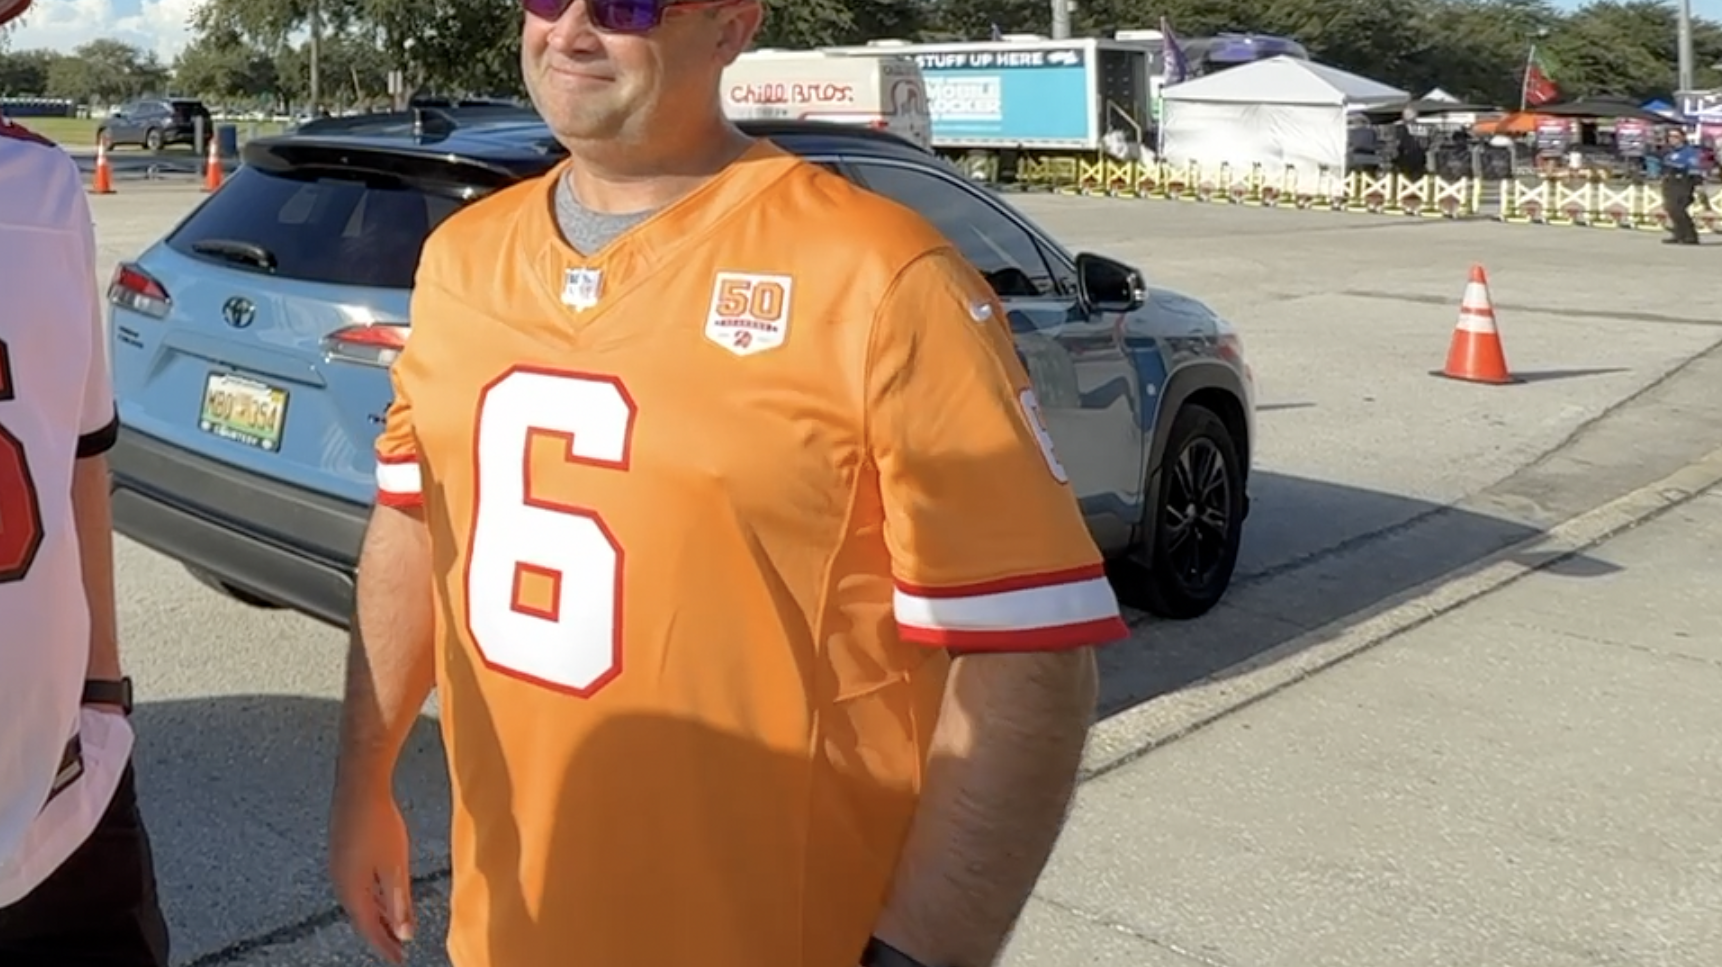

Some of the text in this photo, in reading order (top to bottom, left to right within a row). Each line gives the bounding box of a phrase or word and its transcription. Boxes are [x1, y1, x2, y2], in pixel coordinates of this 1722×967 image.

[915, 53, 967, 68] STUFF
[969, 53, 994, 67] UP
[996, 52, 1044, 66] HERE
[716, 279, 785, 321] 50
[464, 364, 638, 699] 6
